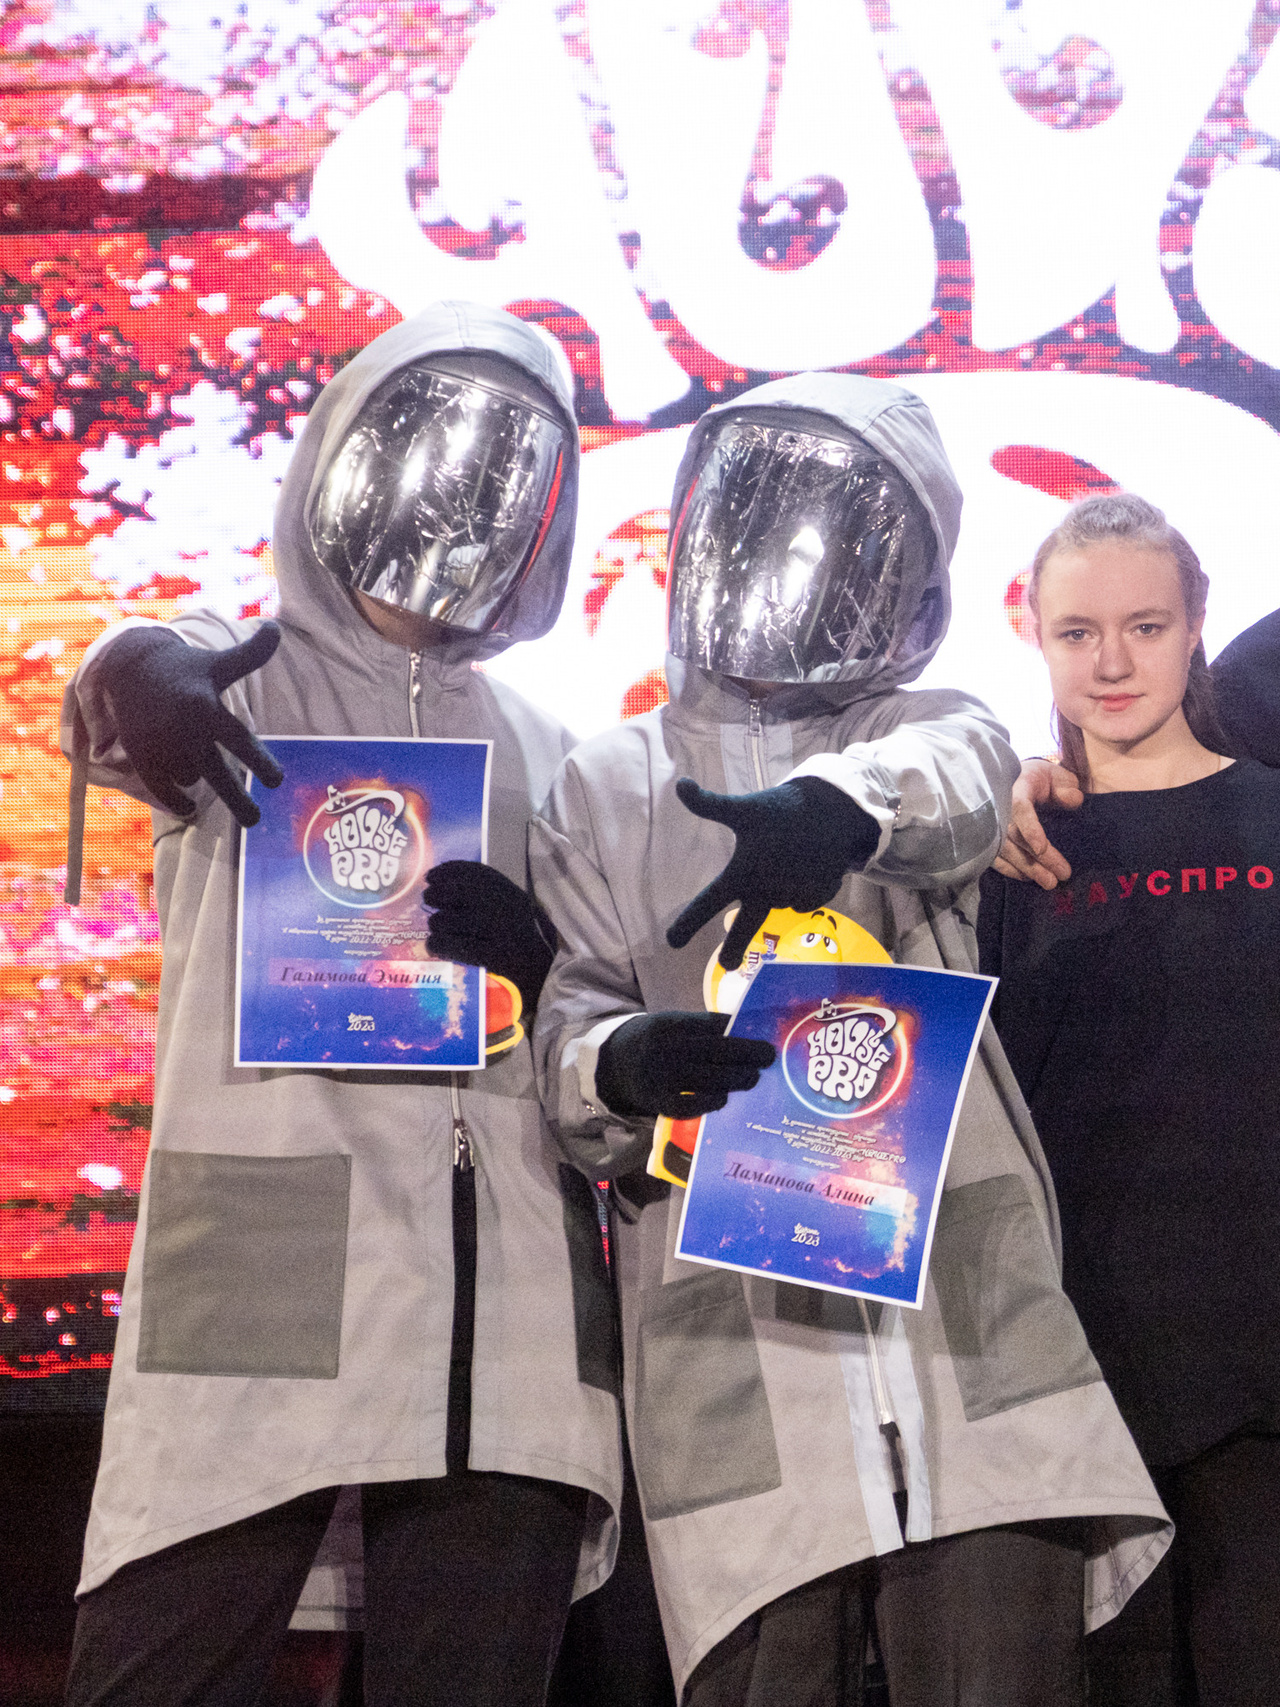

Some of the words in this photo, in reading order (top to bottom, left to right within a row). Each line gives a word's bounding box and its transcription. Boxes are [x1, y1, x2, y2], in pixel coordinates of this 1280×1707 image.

[323, 807, 408, 854] HOUSE
[331, 848, 400, 891] PRO
[281, 967, 367, 983] Галимова
[373, 968, 442, 984] Эмилия
[347, 1021, 375, 1032] 2023
[808, 1017, 891, 1068] HOUSE
[807, 1055, 878, 1102] PRO
[724, 1162, 814, 1194] Даминова
[818, 1183, 875, 1206] Алина
[791, 1231, 820, 1247] 2023
